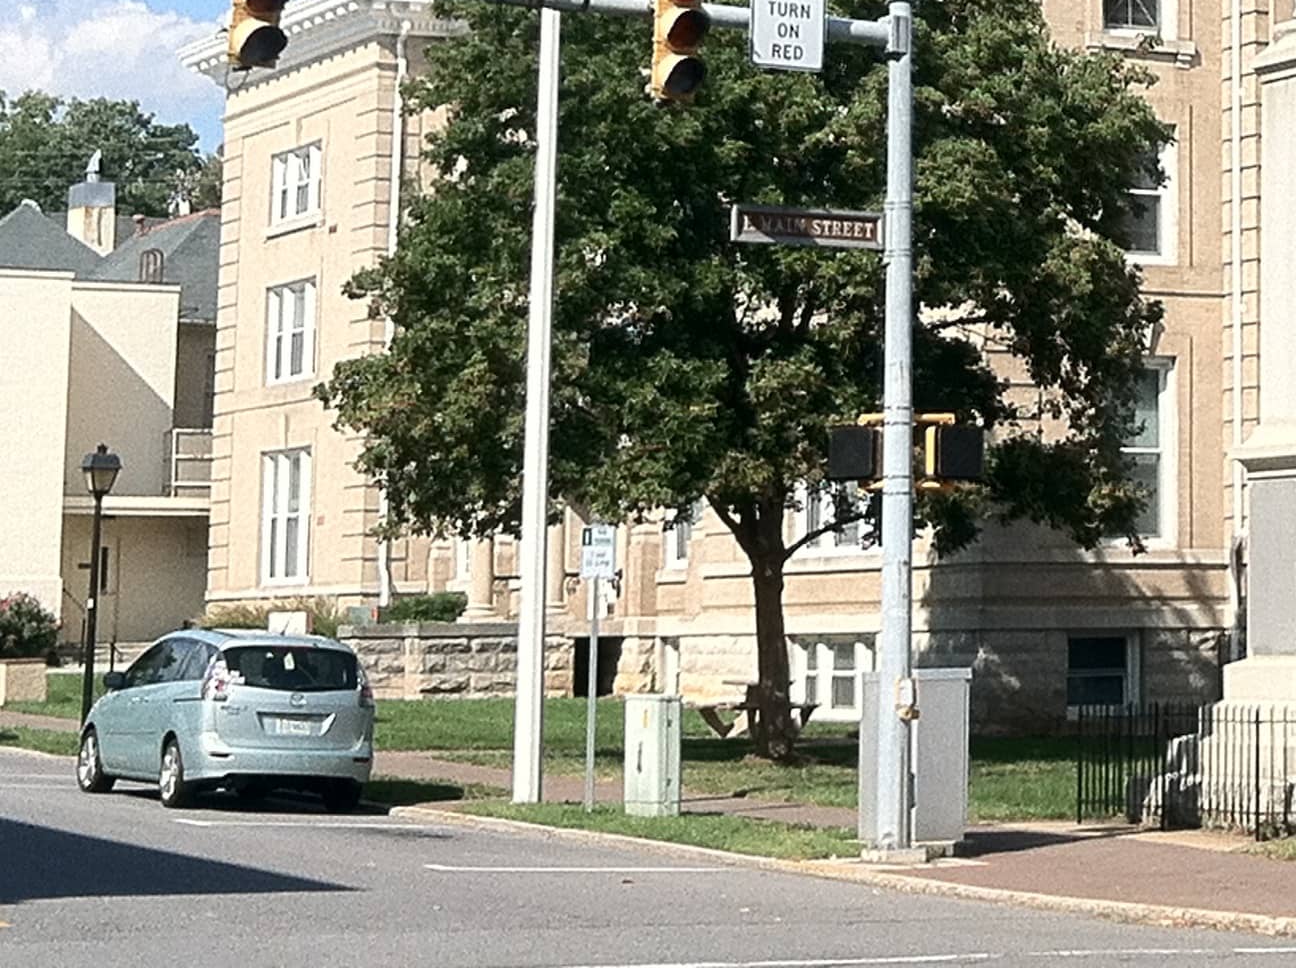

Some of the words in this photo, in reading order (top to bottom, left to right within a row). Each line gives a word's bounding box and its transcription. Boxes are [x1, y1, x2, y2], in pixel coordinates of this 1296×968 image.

[768, 1, 811, 19] TURN
[777, 23, 800, 38] ON
[772, 43, 804, 60] RED
[760, 216, 806, 233] MAIN
[811, 218, 874, 238] STREET
